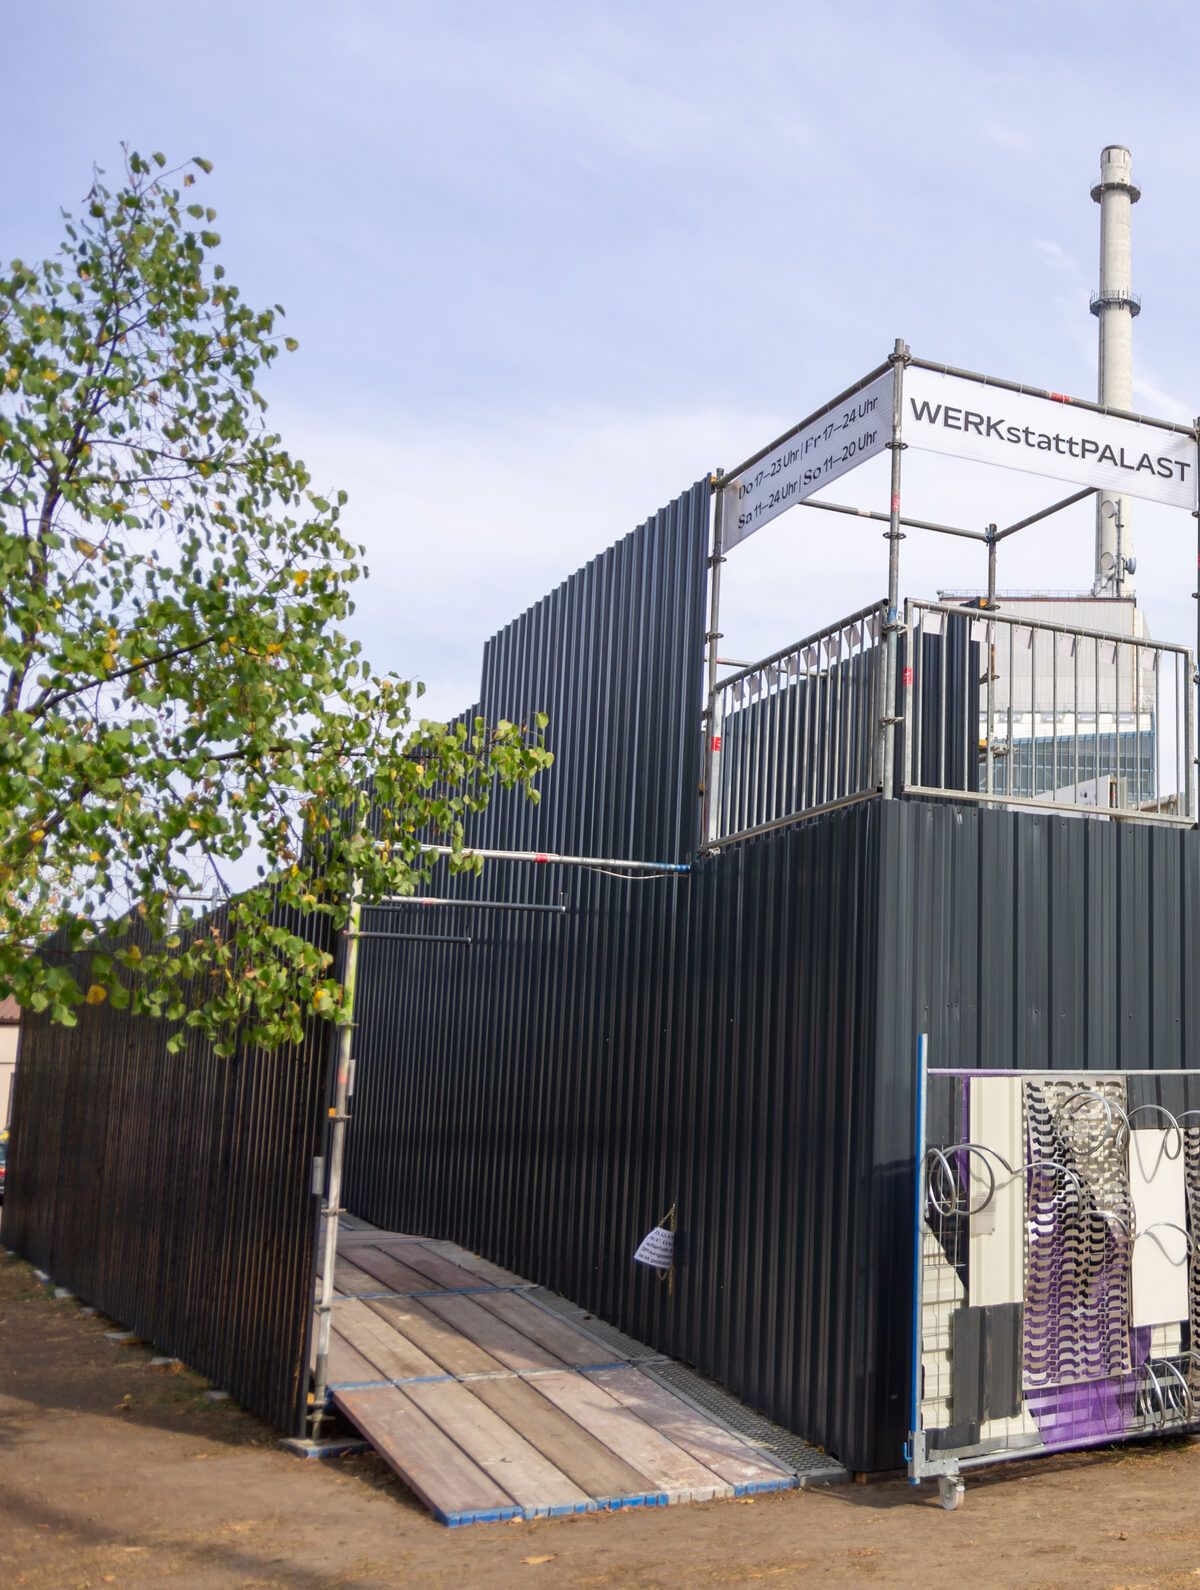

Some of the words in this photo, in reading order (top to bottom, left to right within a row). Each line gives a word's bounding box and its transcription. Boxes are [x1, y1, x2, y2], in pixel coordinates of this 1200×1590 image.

[738, 483, 753, 500] Do
[783, 449, 800, 468] Uhr
[805, 434, 821, 454] Fr
[858, 397, 878, 418] Uhr
[738, 513, 753, 529] Sa
[782, 480, 798, 500] Uhr
[803, 466, 821, 486] So
[858, 430, 878, 451] Uhr
[909, 398, 1191, 482] WERKstattPALAST
